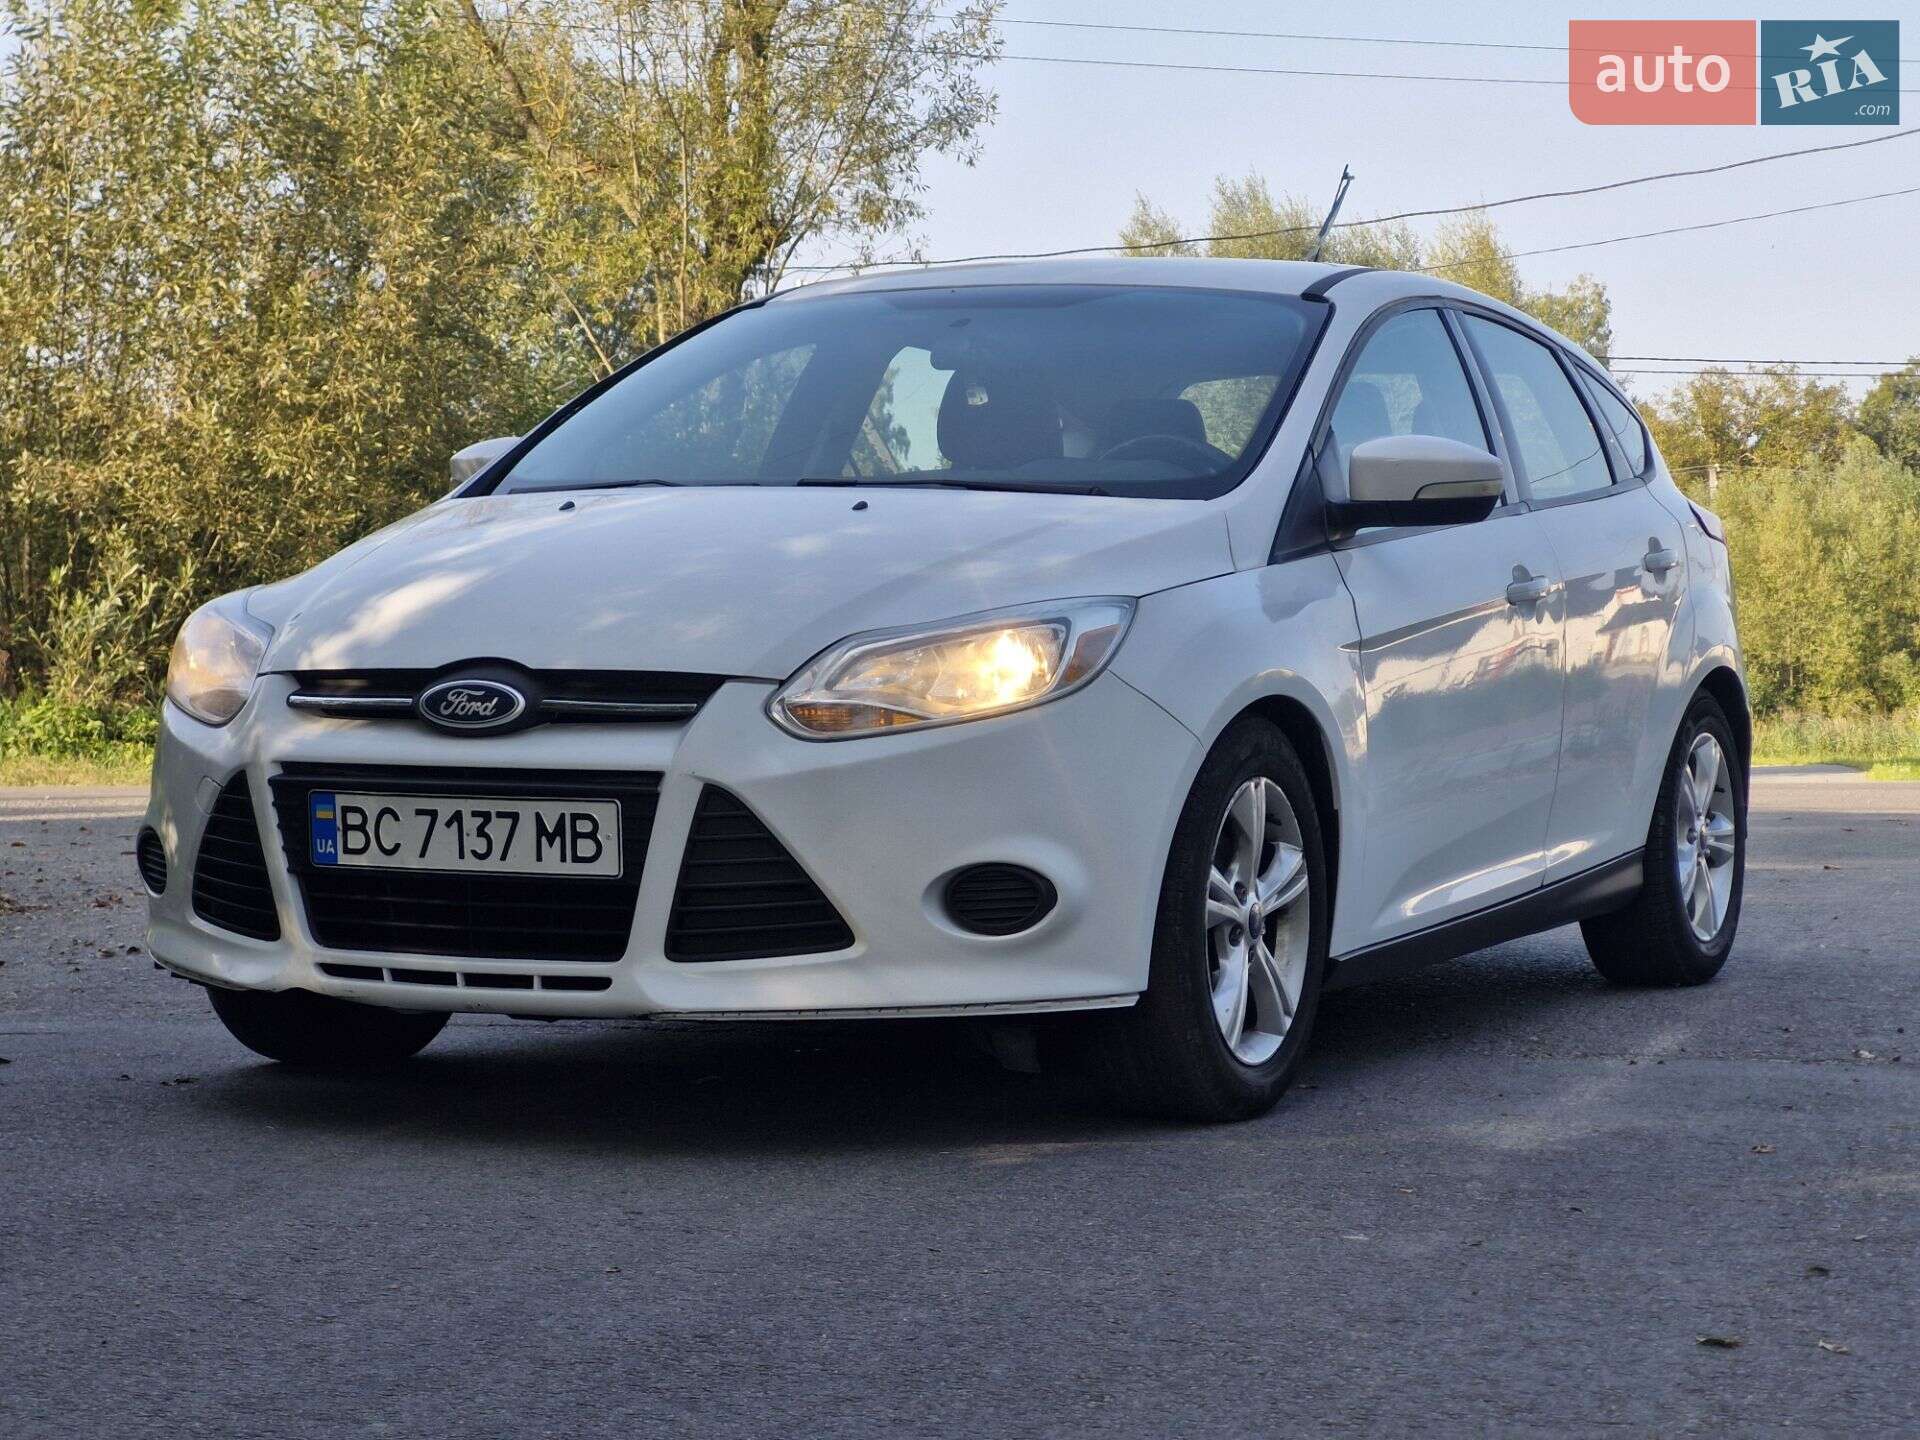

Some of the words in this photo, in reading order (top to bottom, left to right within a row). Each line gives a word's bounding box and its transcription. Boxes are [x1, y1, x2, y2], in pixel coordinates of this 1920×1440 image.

[440, 688, 499, 716] Ford
[316, 838, 335, 855] UA
[340, 805, 402, 857] BC
[414, 808, 520, 862] 7137
[535, 811, 603, 864] MB
